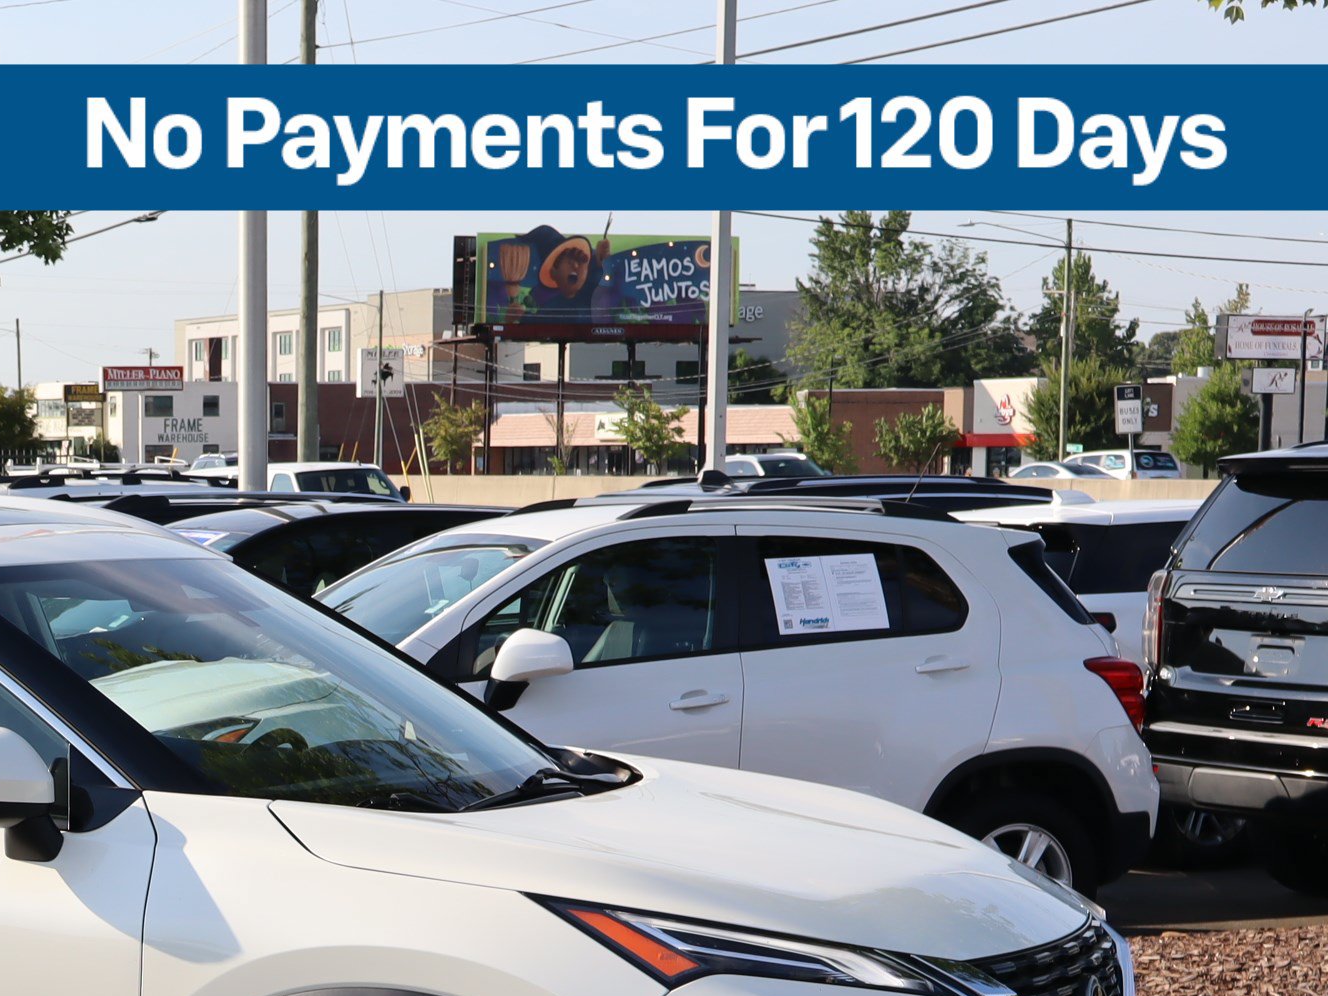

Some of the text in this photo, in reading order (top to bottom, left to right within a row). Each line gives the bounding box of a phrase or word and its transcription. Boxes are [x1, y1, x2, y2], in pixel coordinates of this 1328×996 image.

[624, 257, 695, 283] LEAMOS
[635, 280, 711, 308] JUNTOS
[107, 367, 181, 380] MILLER PIANO
[1119, 407, 1139, 415] BUSES
[163, 418, 203, 432] FRAME
[1121, 417, 1138, 425] ONLY
[157, 432, 209, 443] WAREHOUSE
